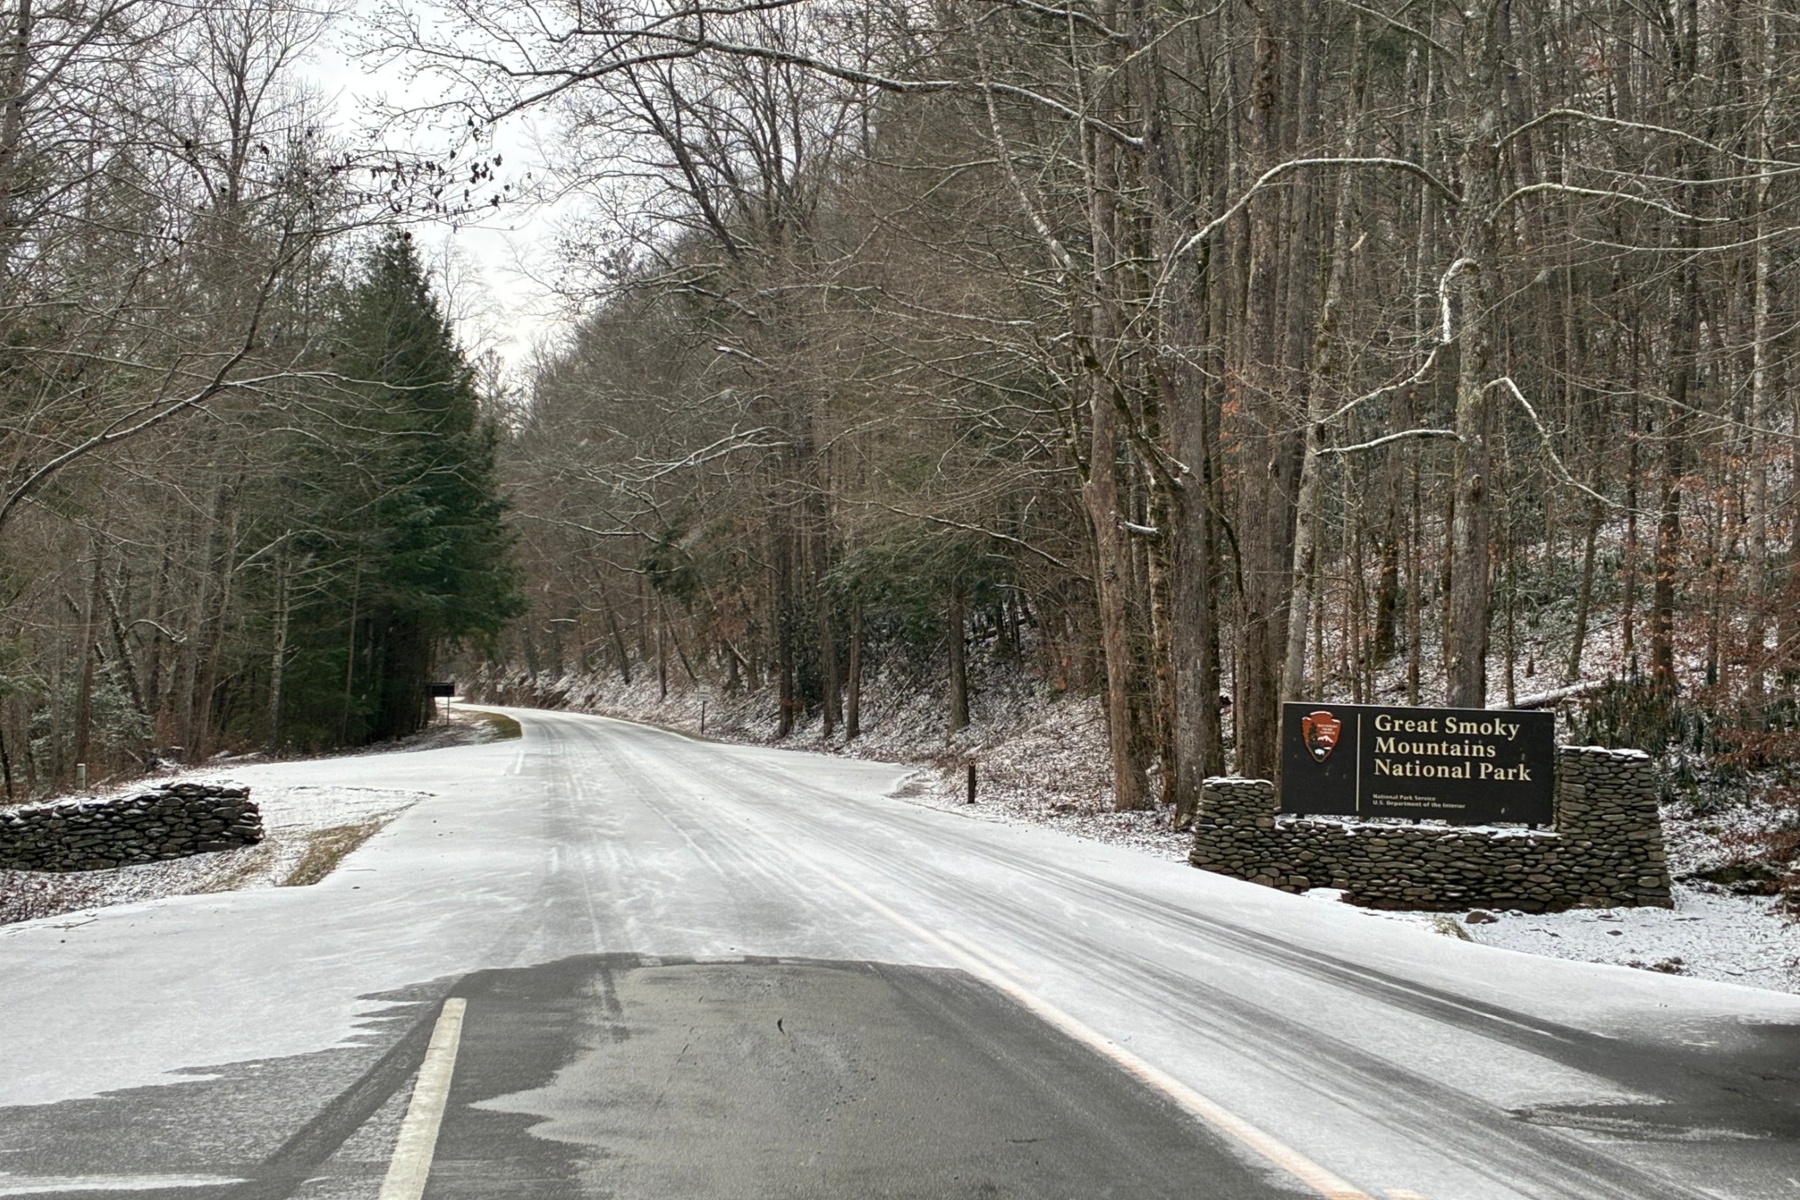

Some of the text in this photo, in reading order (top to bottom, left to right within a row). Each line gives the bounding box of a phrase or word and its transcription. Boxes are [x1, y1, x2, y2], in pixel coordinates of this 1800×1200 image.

[1374, 714, 1520, 741] Great Smoky
[1374, 736, 1496, 758] Mountains
[1374, 758, 1532, 781] National Park
